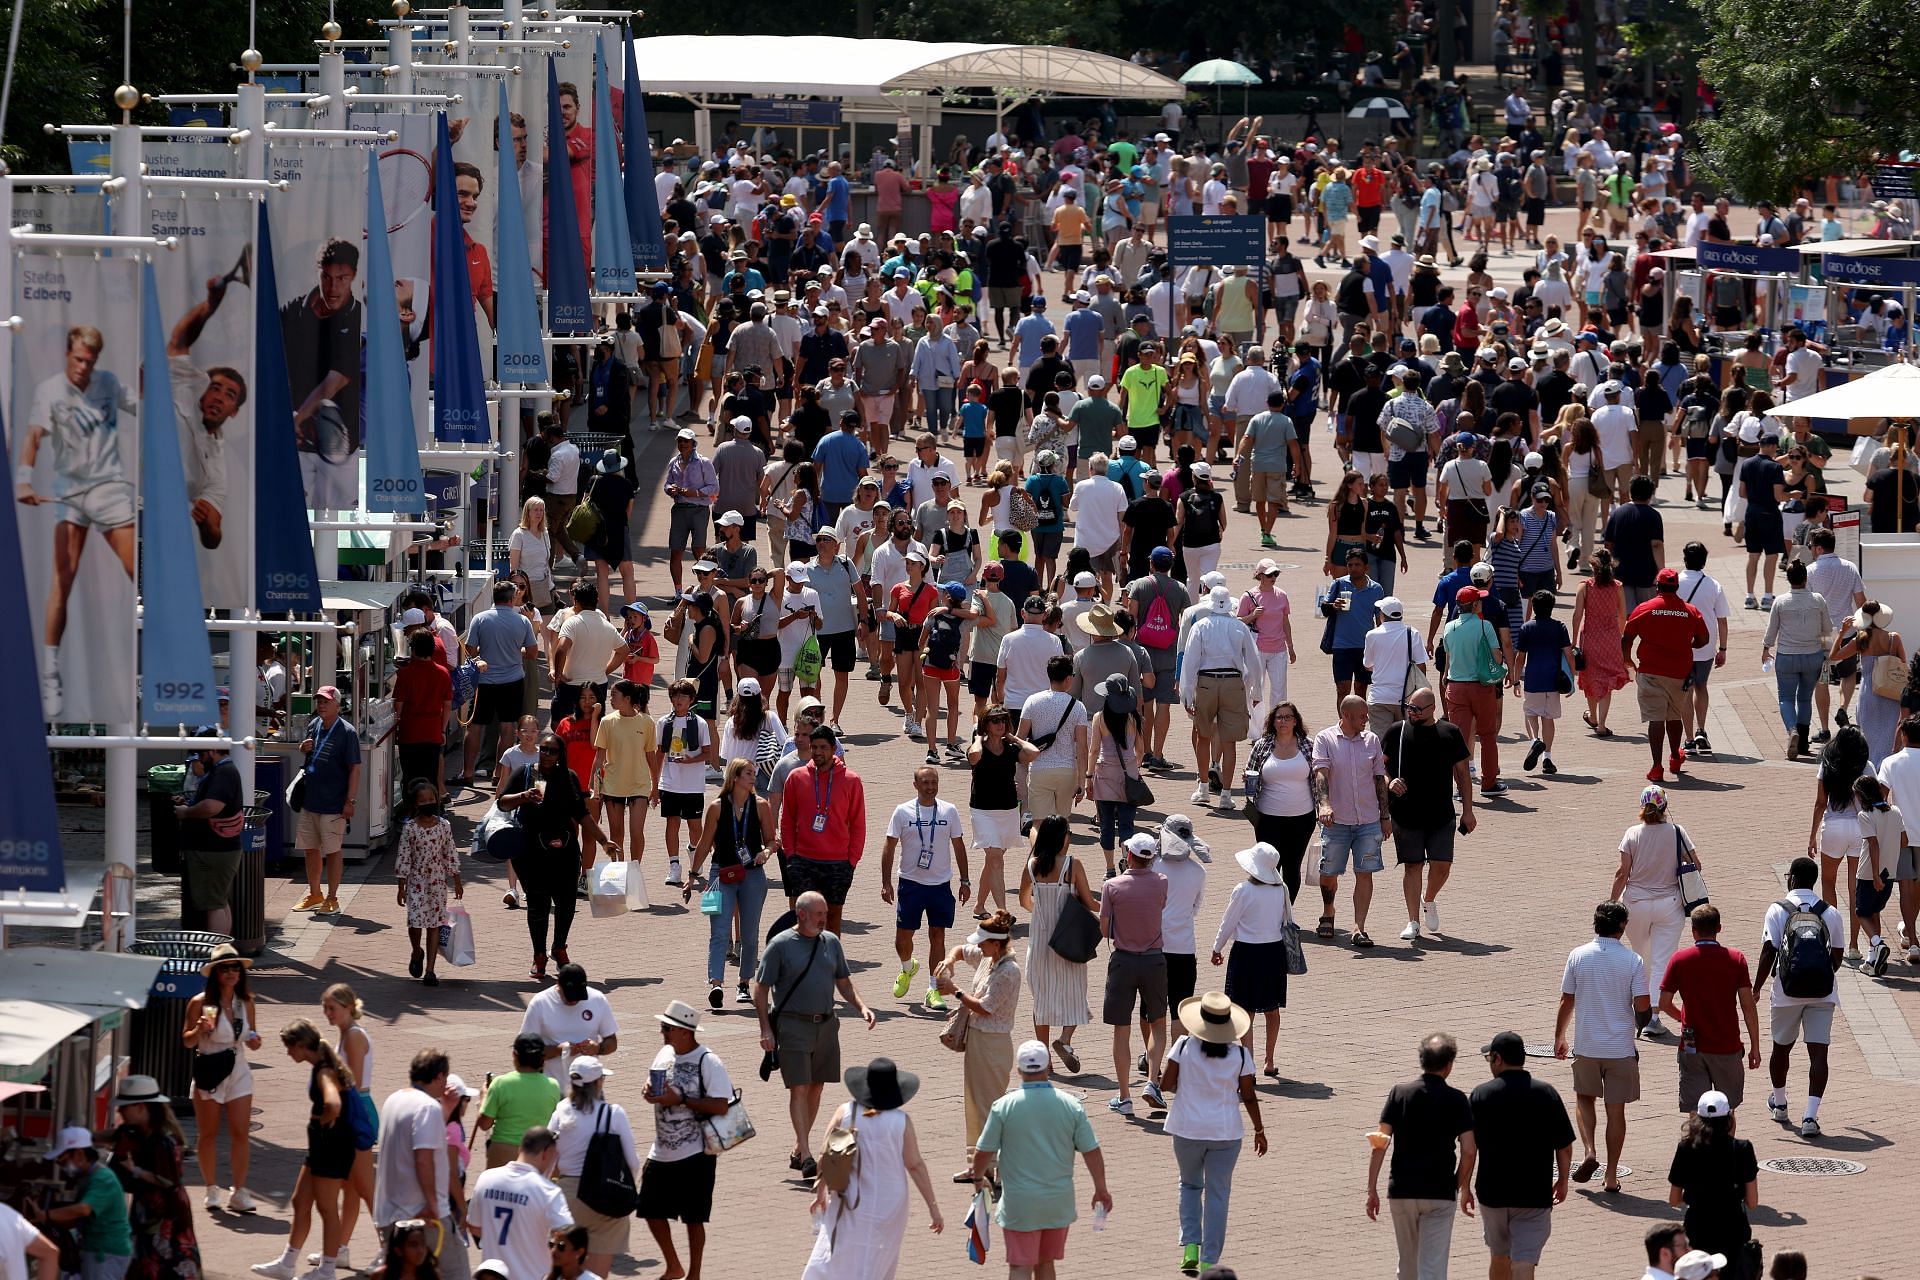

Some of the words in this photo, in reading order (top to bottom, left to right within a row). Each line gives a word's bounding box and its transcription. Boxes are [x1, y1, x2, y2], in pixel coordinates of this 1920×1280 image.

[273, 157, 304, 169] Marat
[273, 170, 302, 181] Safin
[12, 208, 43, 219] erena
[152, 209, 179, 221] Pete
[152, 224, 206, 237] Sampras
[1704, 250, 1721, 261] GREY
[1722, 251, 1758, 265] GOOSE
[601, 267, 629, 278] 2016
[1828, 262, 1845, 273] GREY
[1846, 262, 1882, 276] GOOSE
[23, 270, 66, 284] Stefan
[23, 286, 72, 302] Edberg
[555, 305, 585, 317] 2012
[555, 317, 585, 325] Champions
[503, 354, 541, 366] 2008
[442, 409, 481, 422] 2004
[444, 422, 477, 431] Champions
[373, 478, 417, 492] 2000
[266, 572, 310, 589] 1996
[266, 590, 310, 600] Champions
[1651, 609, 1689, 618] SUPERVISOR
[154, 683, 205, 700] 1992
[0, 841, 49, 861] 988
[484, 1189, 529, 1206] RODRIGUEZ
[494, 1206, 514, 1246] 7
